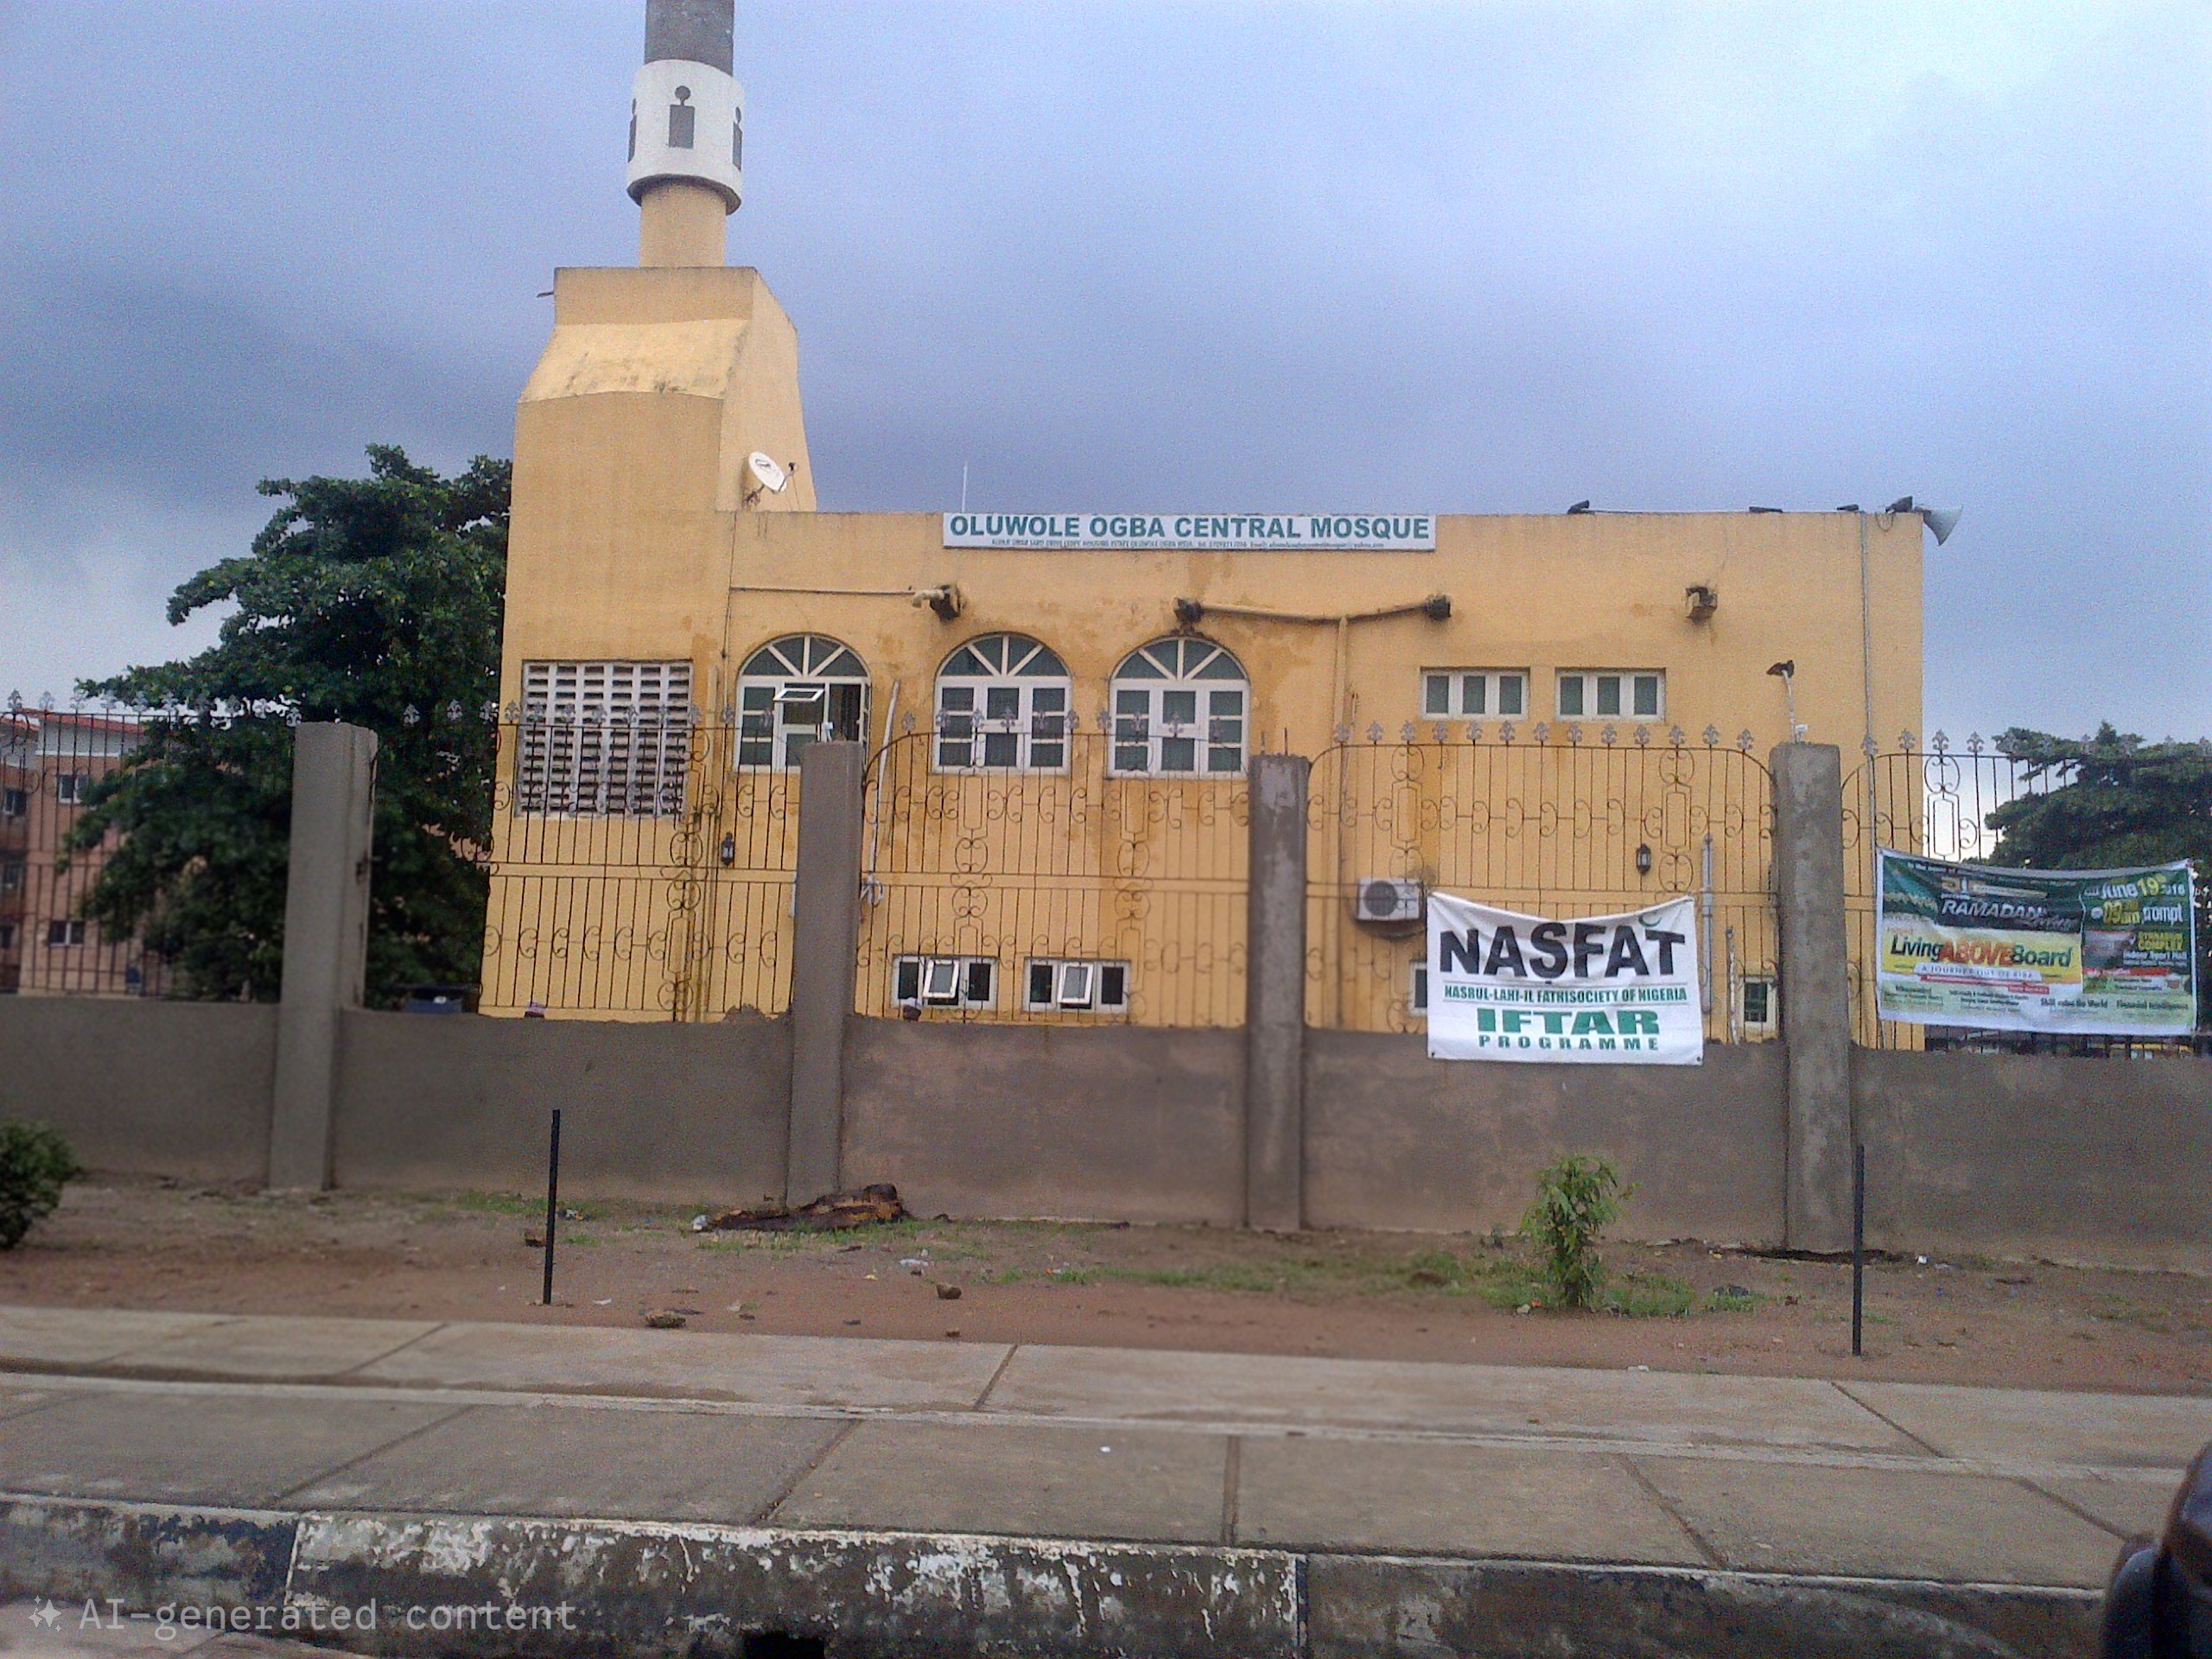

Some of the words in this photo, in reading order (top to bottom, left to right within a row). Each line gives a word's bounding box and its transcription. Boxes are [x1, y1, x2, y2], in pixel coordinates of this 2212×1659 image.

[950, 516, 1080, 537] OLUWOLE
[1090, 517, 1165, 537] OGBA
[1174, 517, 1300, 538] CENTRAL
[1310, 518, 1429, 540] MOSQUE
[2101, 882, 2139, 899] June
[1440, 922, 1685, 978] NASFAT
[1622, 988, 1637, 1002] OF
[1638, 988, 1688, 1001] NIGERIA
[1477, 1007, 1660, 1035] IFTAR
[1478, 1035, 1659, 1051] PROGRAMME
